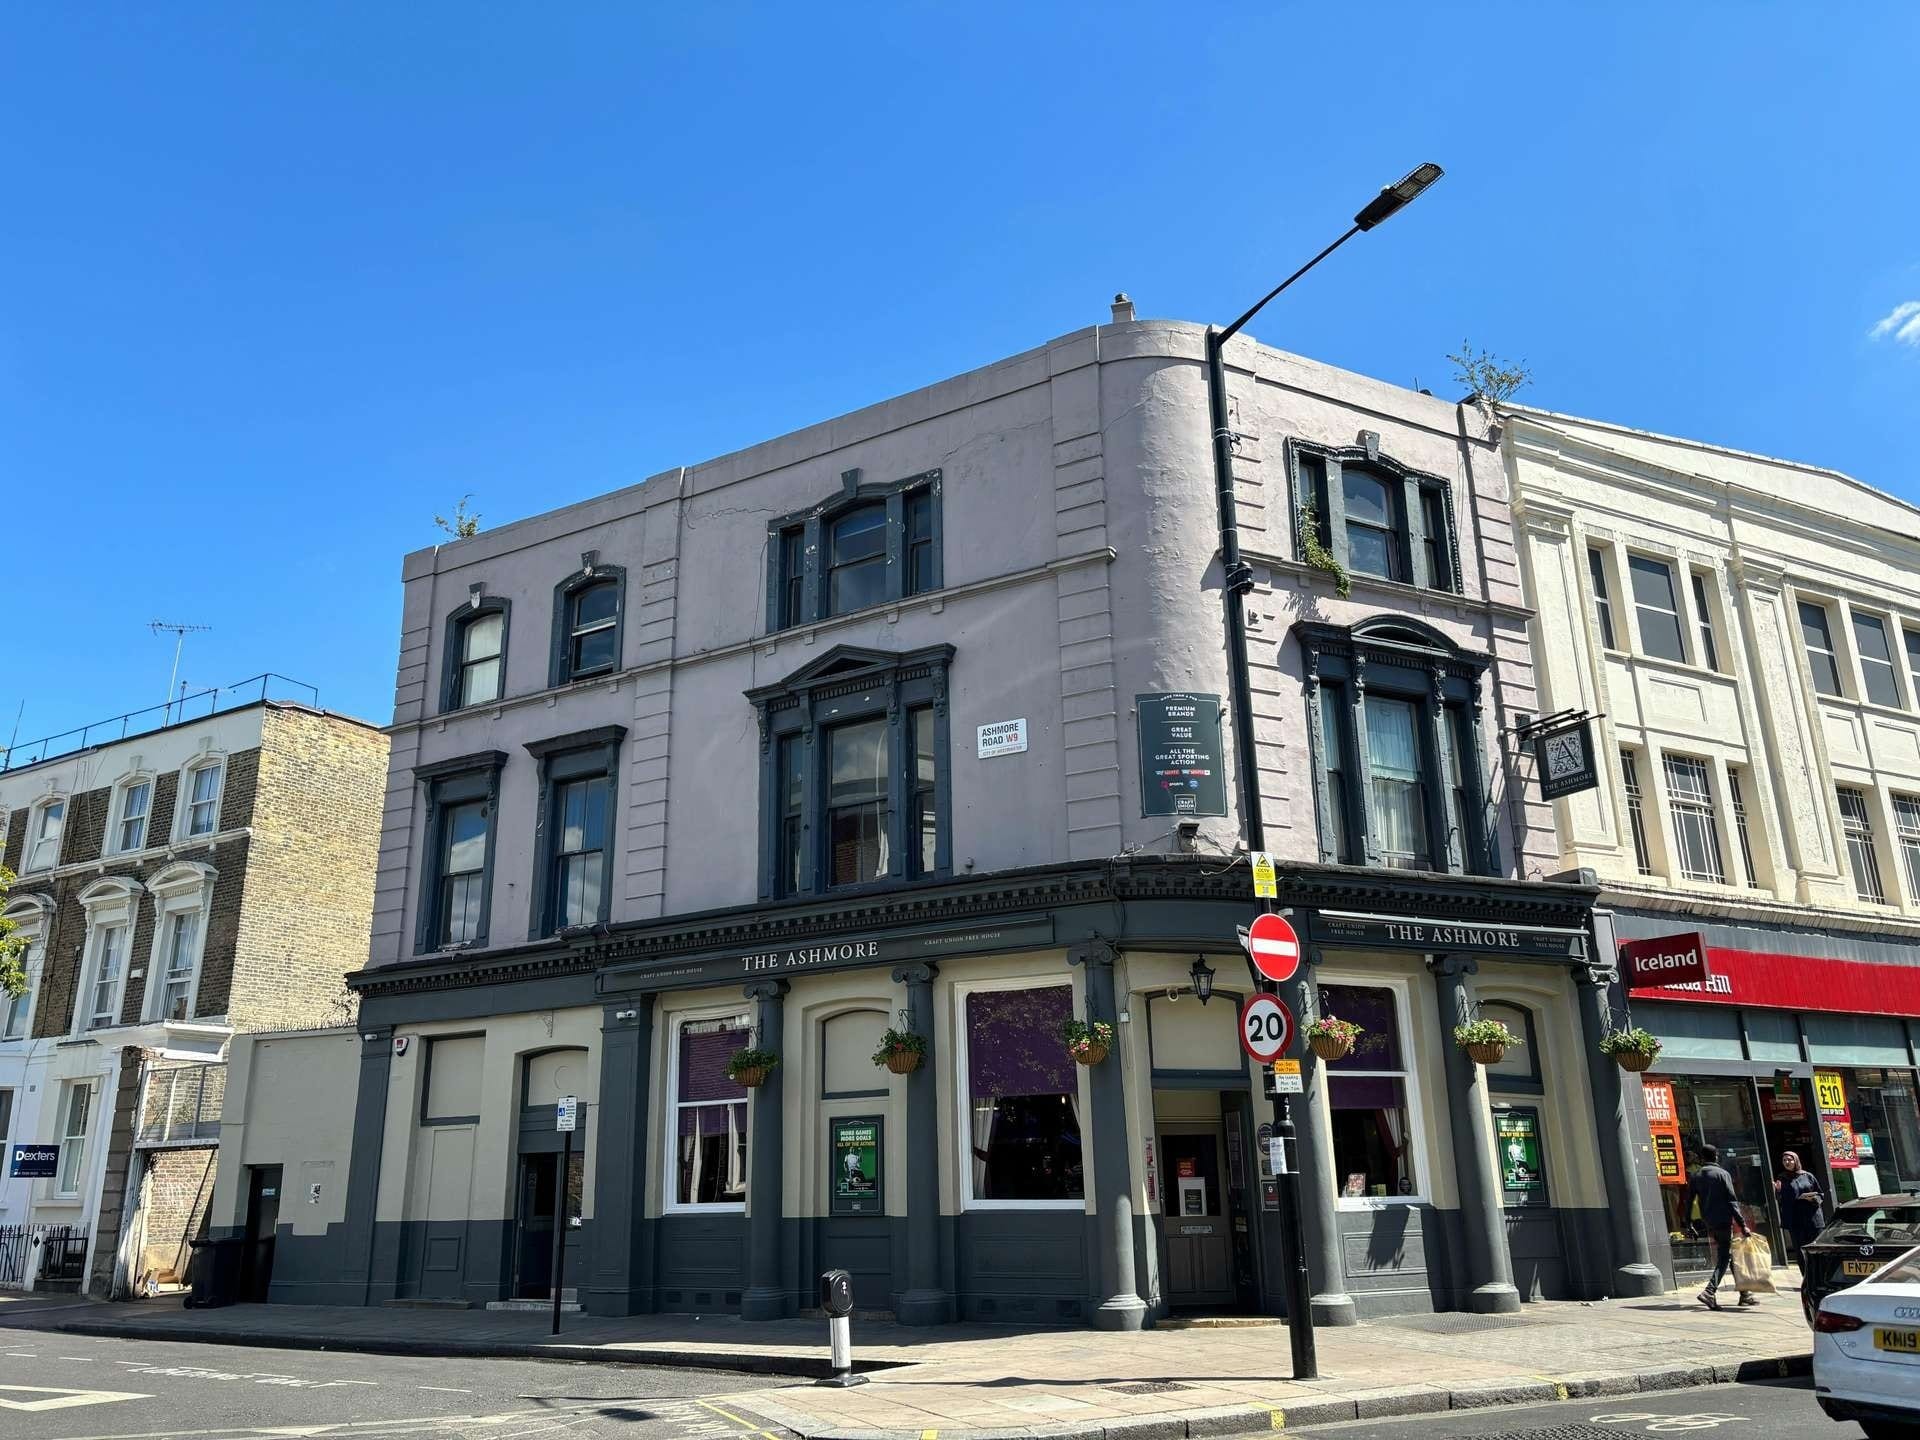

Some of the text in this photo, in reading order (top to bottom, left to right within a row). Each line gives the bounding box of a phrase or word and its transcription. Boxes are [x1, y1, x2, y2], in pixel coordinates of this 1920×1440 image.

[982, 722, 1019, 737] ASHMORE
[982, 732, 1019, 748] ROAD W9
[1544, 782, 1558, 791] THE
[1560, 772, 1594, 787] ASHMORE
[1385, 924, 1520, 947] THE ASHMORE
[742, 941, 879, 971] THE ASHMORE
[1635, 949, 1698, 972] Iceland
[1705, 974, 1733, 994] Hill
[1248, 1012, 1284, 1043] 20
[1643, 1087, 1670, 1108] REE
[1820, 1085, 1841, 1106] £10
[1646, 1108, 1671, 1120] ELIVERY
[16, 1150, 56, 1161] Dexters
[1848, 1262, 1875, 1273] FN72
